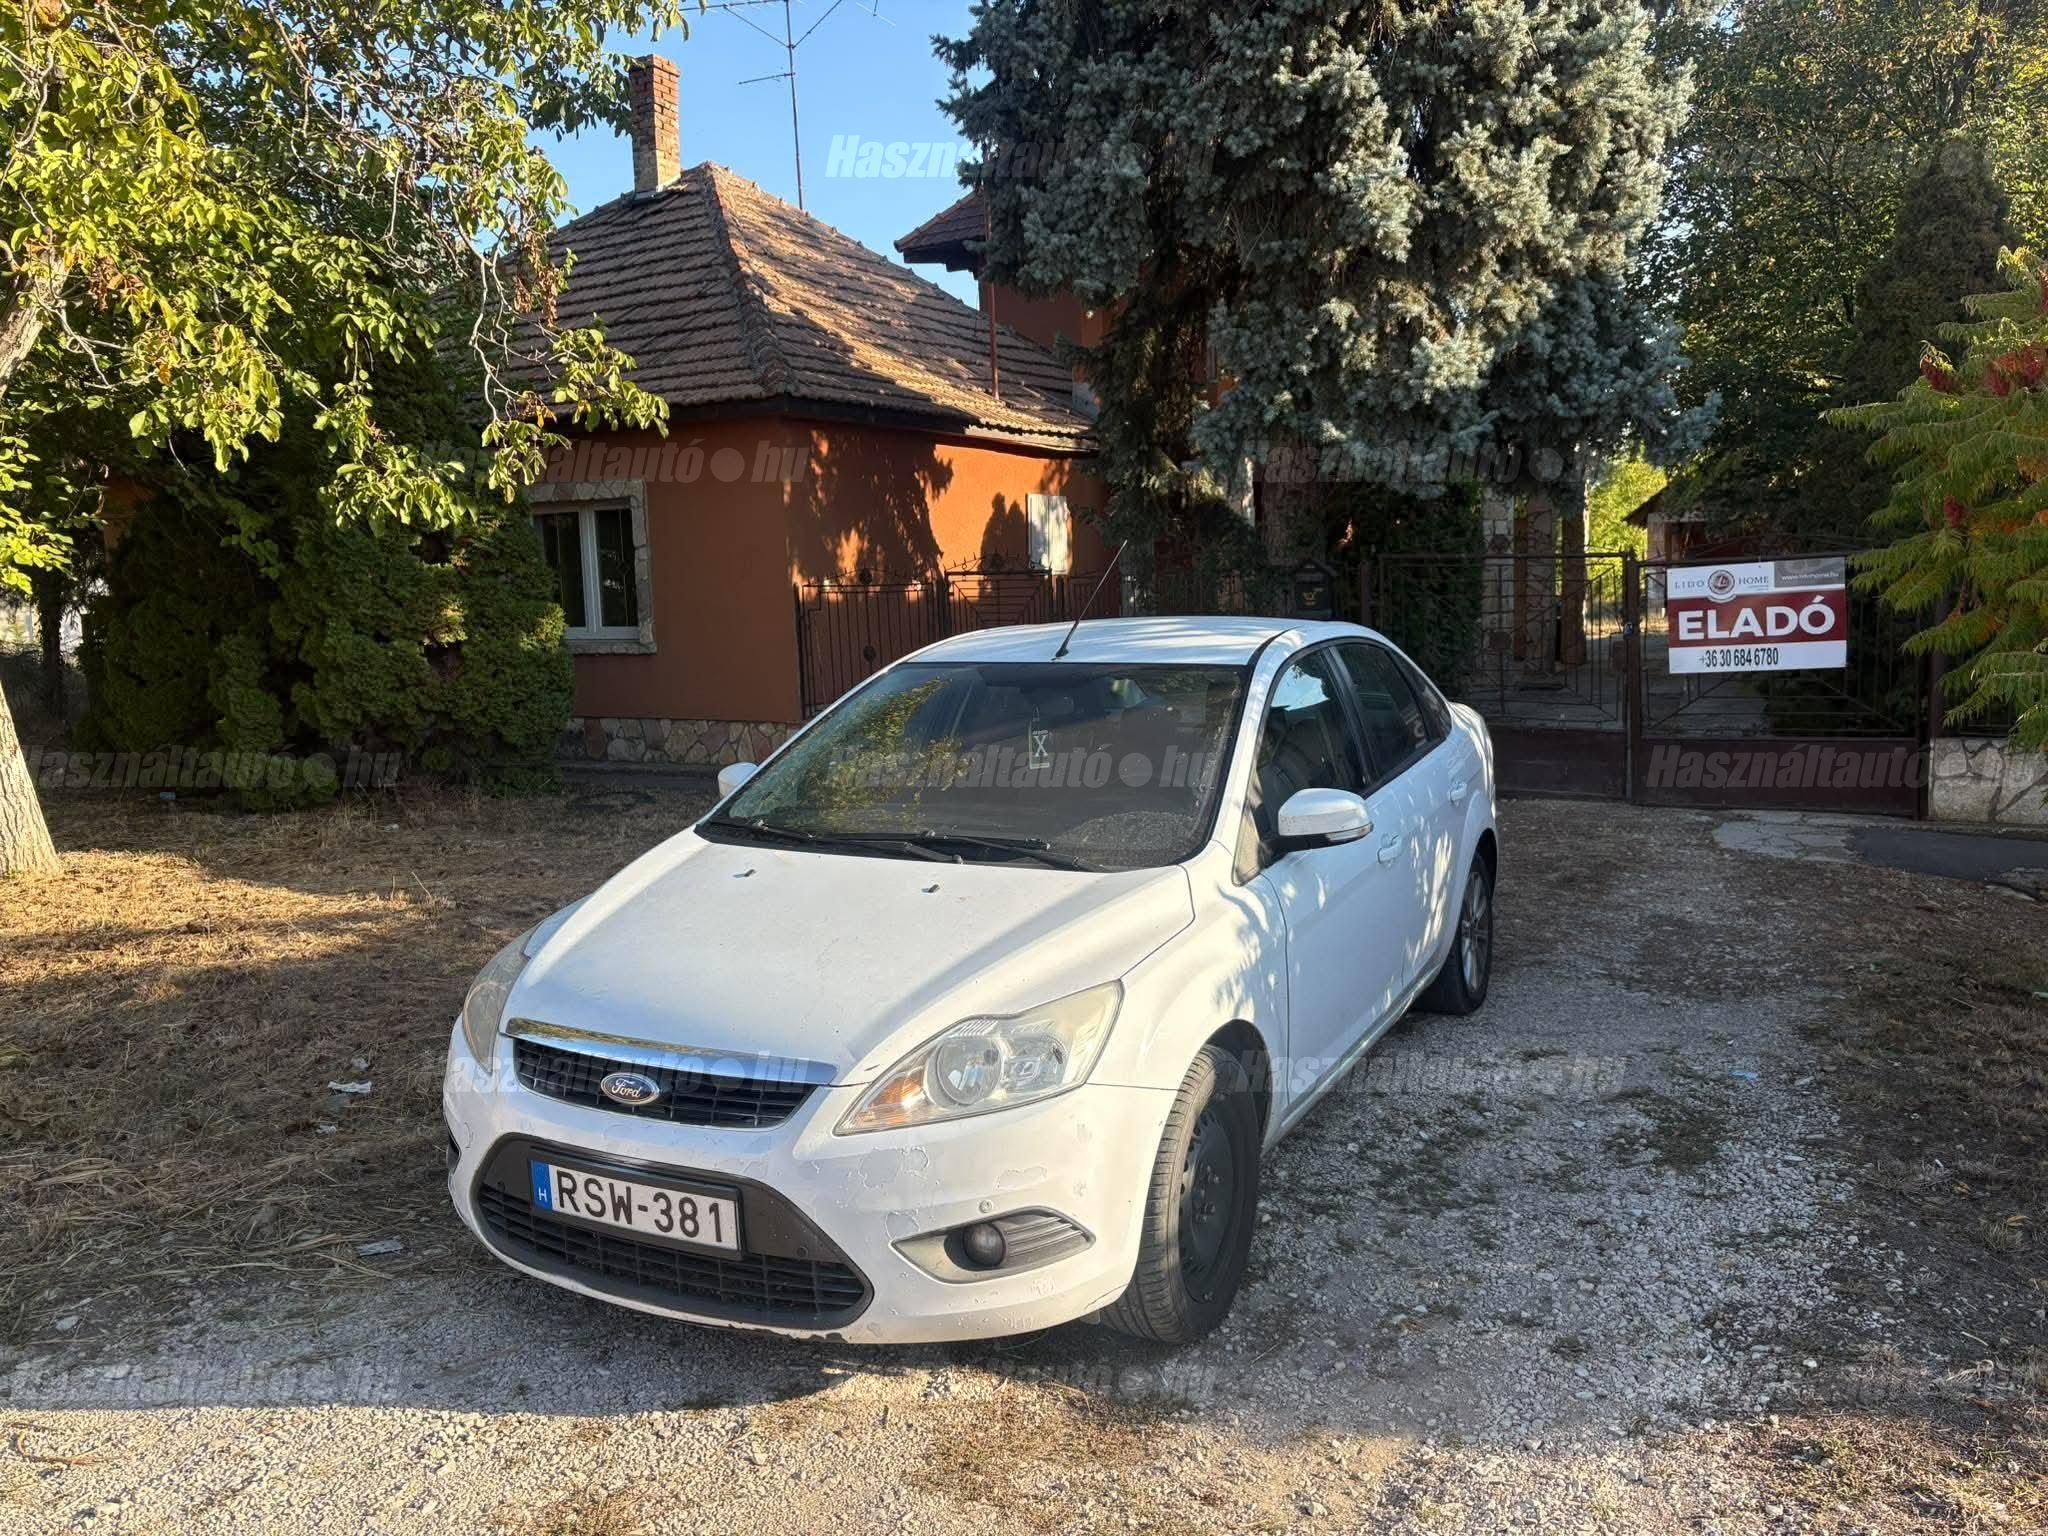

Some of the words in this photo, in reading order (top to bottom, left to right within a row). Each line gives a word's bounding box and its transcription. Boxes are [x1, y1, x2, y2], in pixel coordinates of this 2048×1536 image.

[1674, 580, 1705, 589] LIDO
[1738, 575, 1769, 585] HOME
[1678, 594, 1836, 641] ELADÓ
[1699, 649, 1718, 668] +36
[1719, 648, 1732, 667] 30
[1733, 648, 1752, 666] 684
[1754, 647, 1779, 666] 6780
[611, 1078, 643, 1098] Ford
[538, 1187, 548, 1202] H
[556, 1169, 723, 1243] RSW-381
